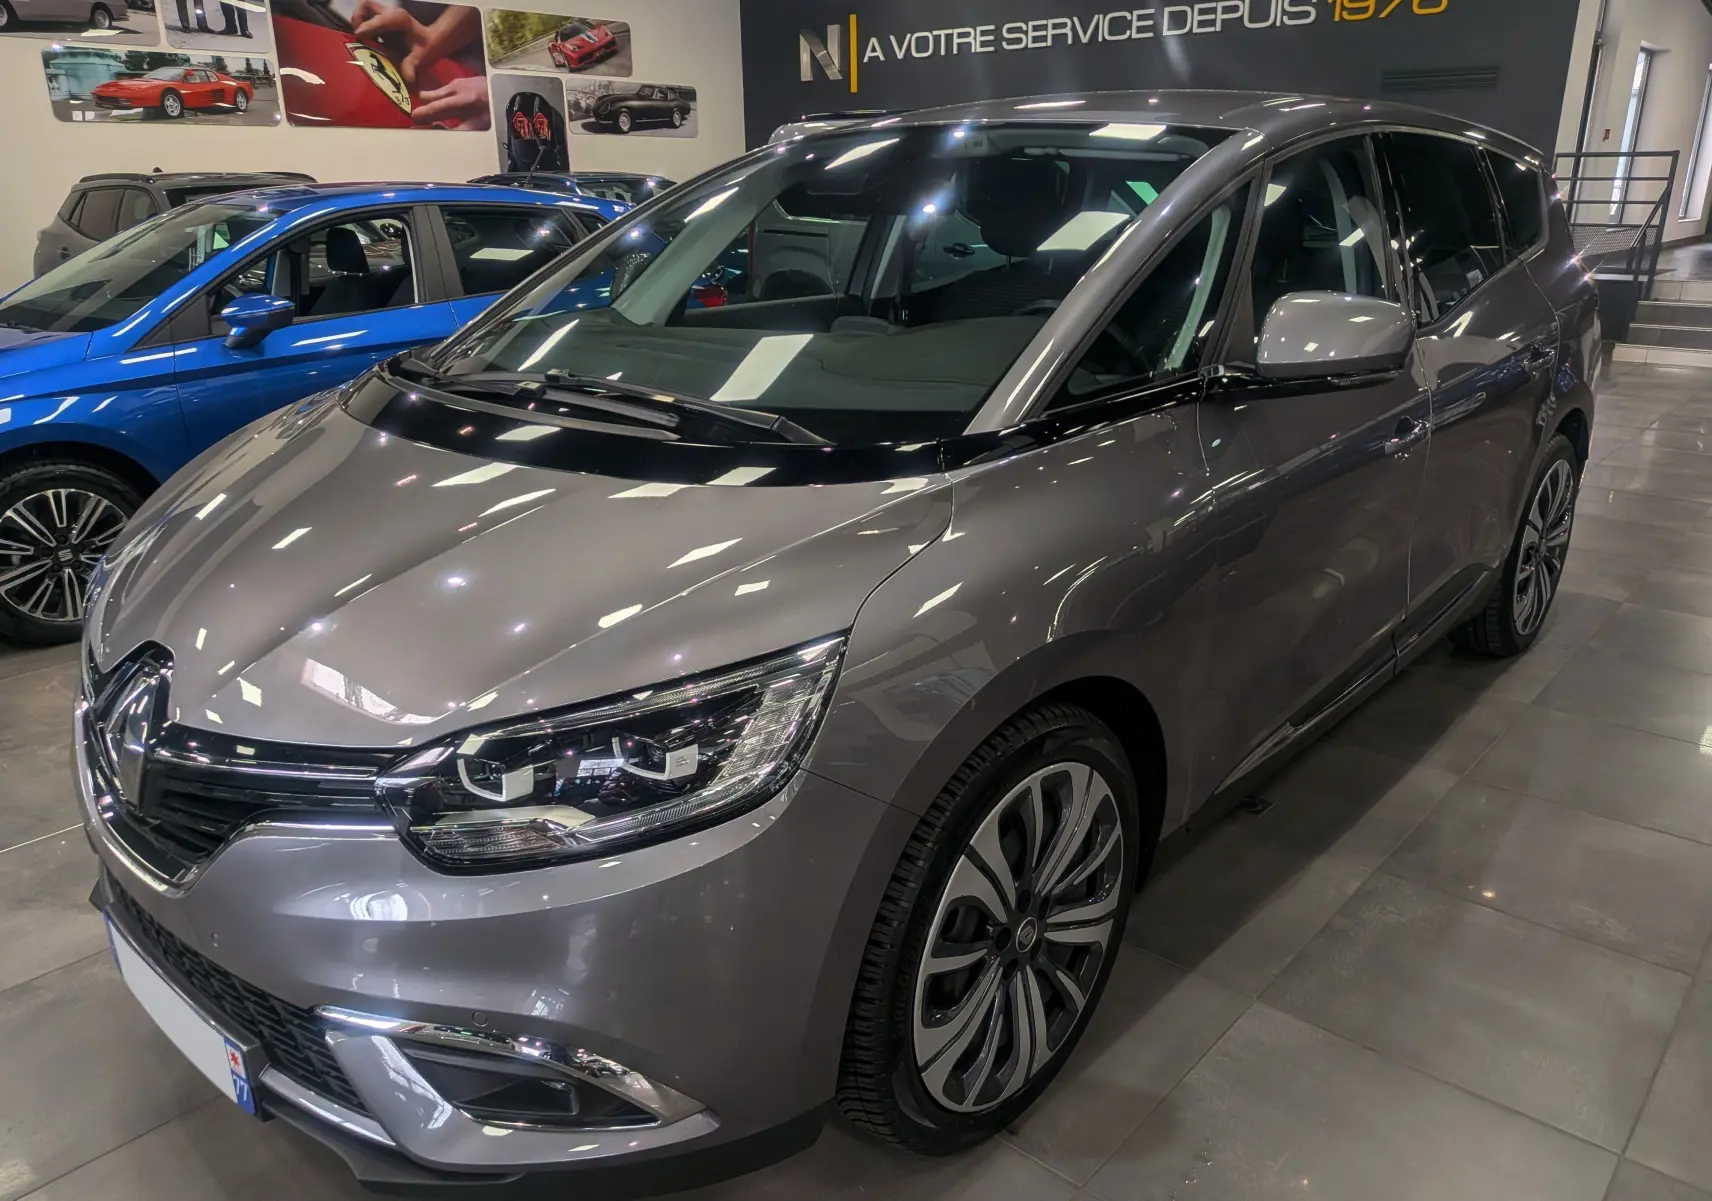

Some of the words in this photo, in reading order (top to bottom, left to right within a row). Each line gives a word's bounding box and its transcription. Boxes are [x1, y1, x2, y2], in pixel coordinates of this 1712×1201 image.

[800, 24, 843, 81] N
[863, 37, 885, 63] A
[889, 25, 996, 60] VOTRE
[1002, 9, 1155, 50] SERVICE
[1163, 0, 1317, 36] DEPUIS
[232, 1073, 248, 1102] 77
